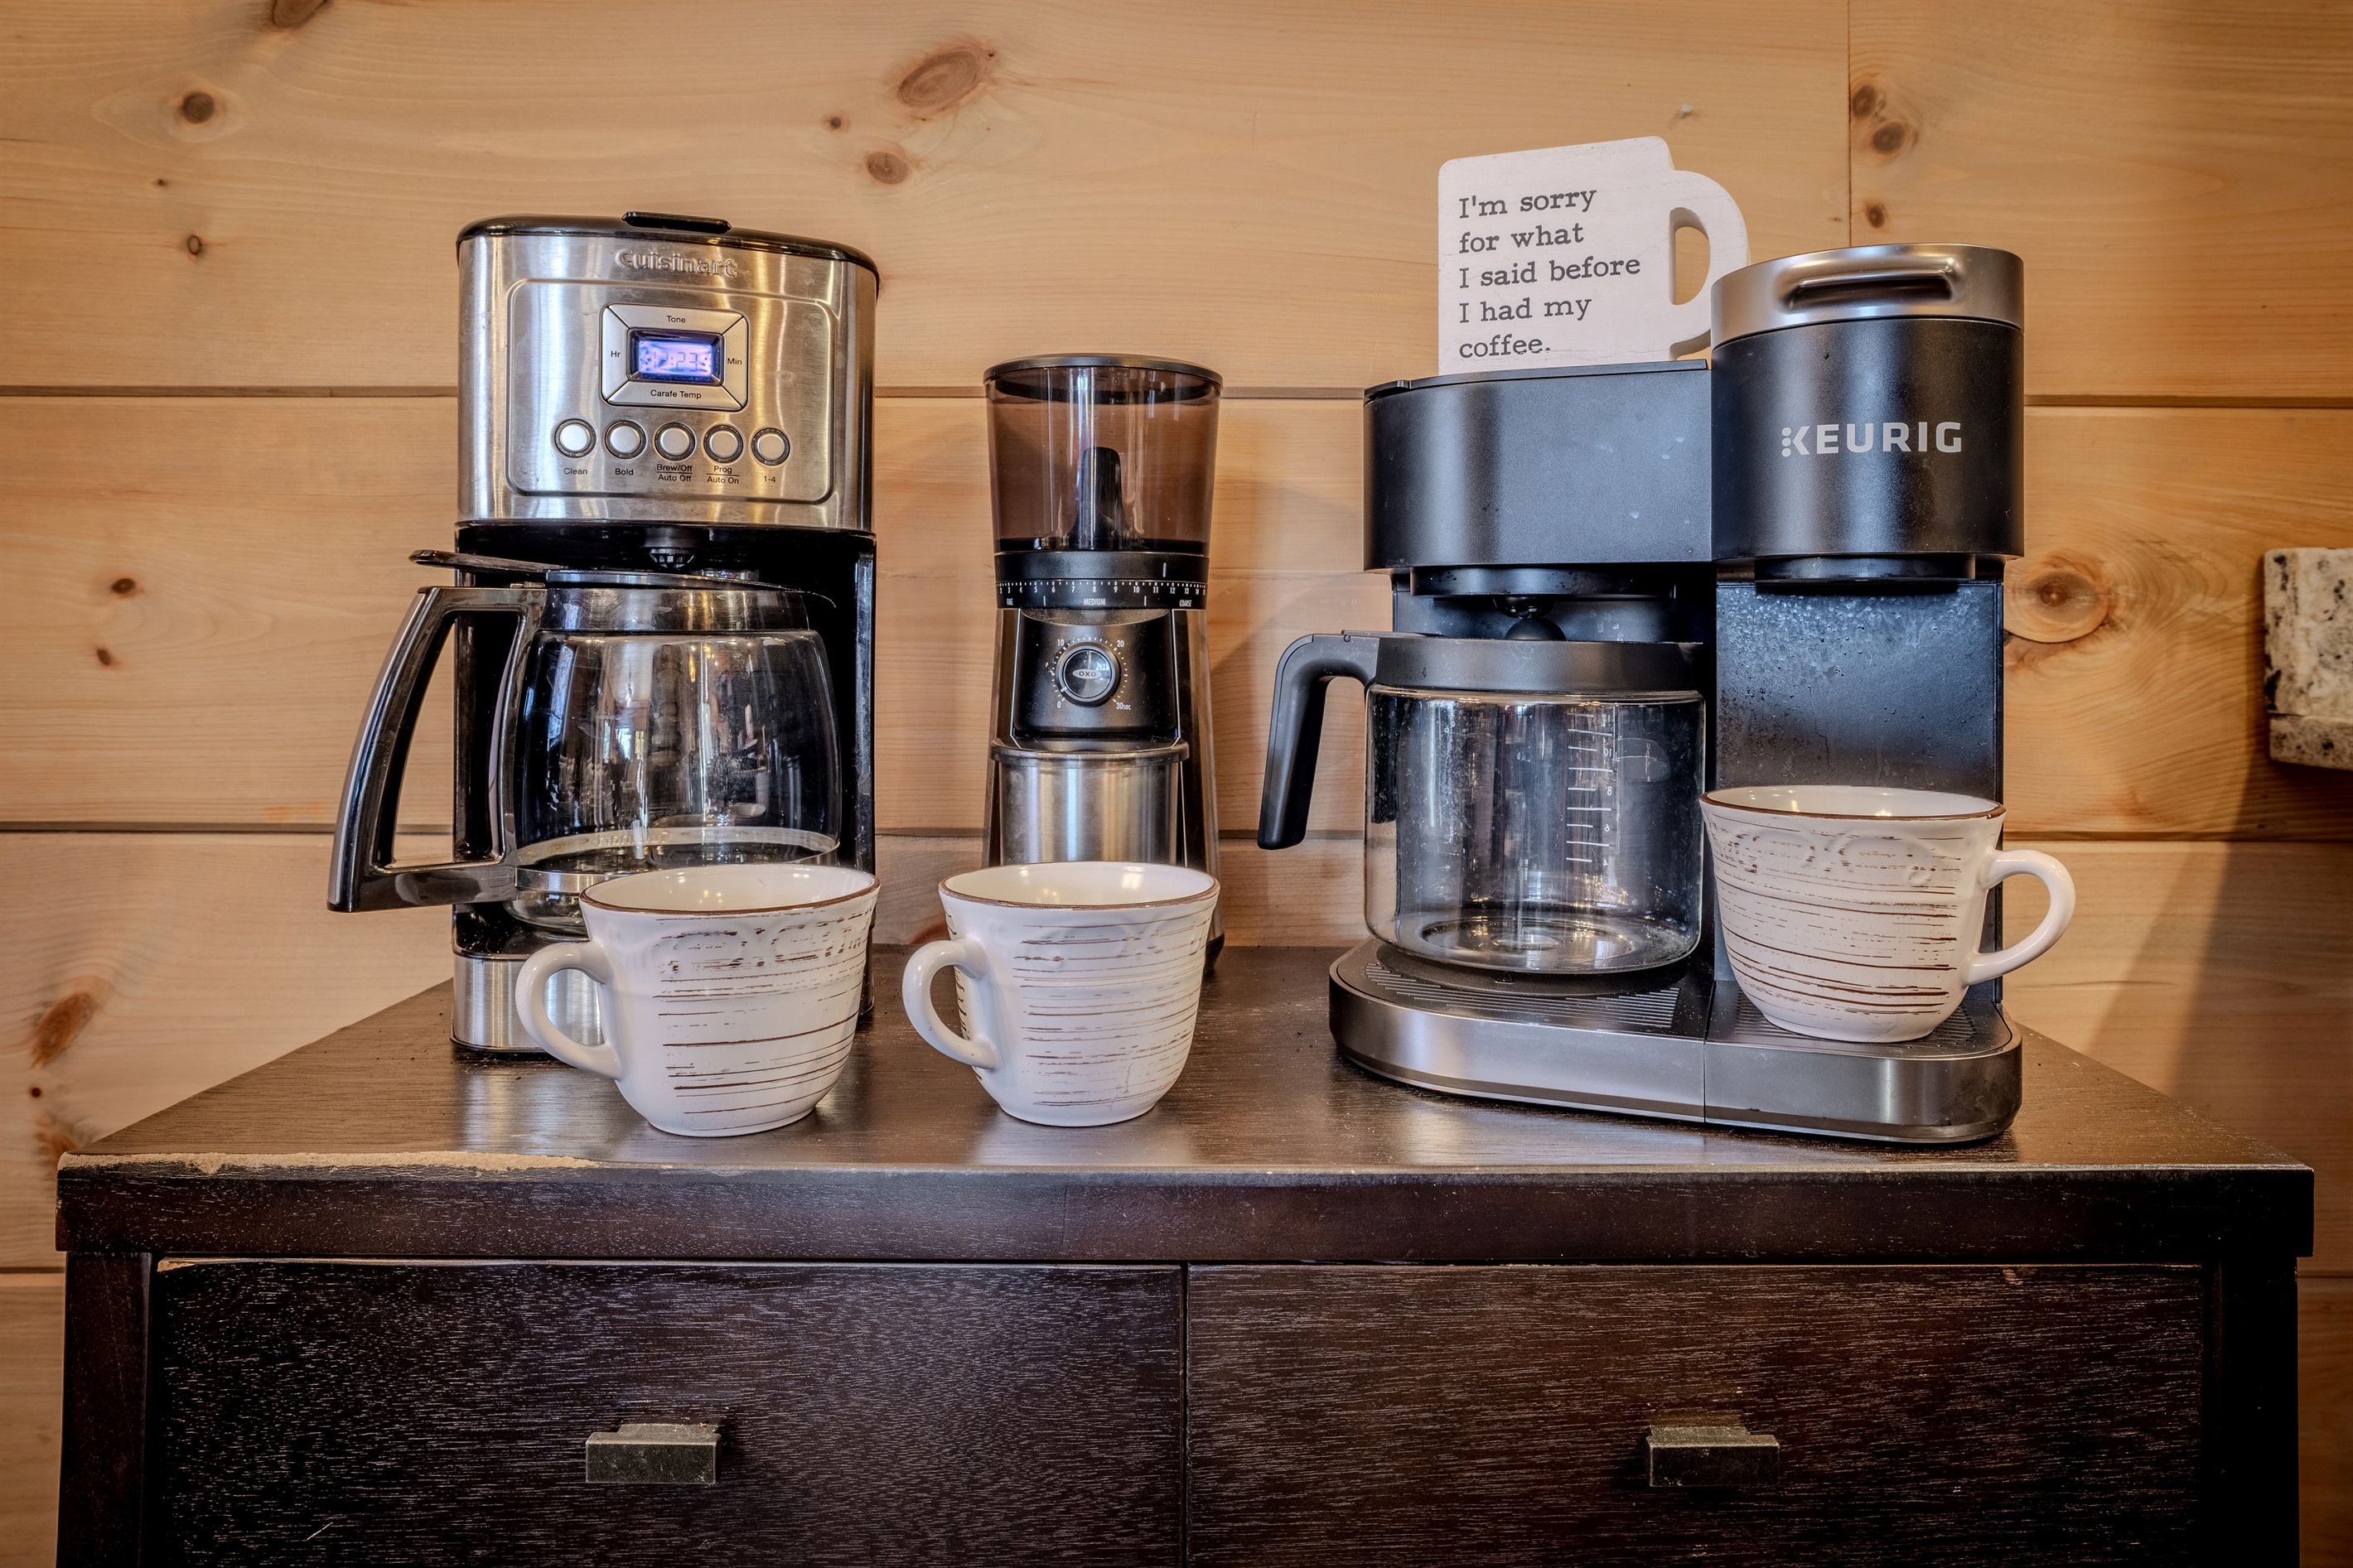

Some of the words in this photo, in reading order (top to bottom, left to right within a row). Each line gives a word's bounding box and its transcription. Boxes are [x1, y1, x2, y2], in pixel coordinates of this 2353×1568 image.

[1459, 195, 1508, 219] I'm
[1520, 189, 1597, 212] sorry
[1459, 232, 1500, 254] for
[1510, 222, 1584, 248] what
[615, 248, 737, 277] Cuisinart
[1459, 268, 1470, 288] I
[1480, 262, 1537, 287] said
[1549, 256, 1641, 282] before
[1459, 302, 1470, 324] I
[1480, 297, 1532, 322] had
[1544, 298, 1592, 321] my
[666, 315, 686, 324] Tone
[1459, 333, 1551, 359] coffee.
[727, 357, 742, 365] Min
[650, 389, 678, 398] Carafe
[679, 391, 702, 399] Temp
[1781, 421, 1962, 457] KEURIG
[563, 467, 588, 475] Clean
[615, 467, 634, 475] Bold
[656, 464, 693, 472] Brew/Off
[713, 466, 732, 475] Prog
[679, 473, 692, 482] Off
[707, 475, 726, 484] Auto
[727, 476, 739, 485] On
[1152, 586, 1159, 594] 11
[1083, 597, 1106, 606] MEDIUM
[1116, 639, 1125, 648] 20
[1056, 701, 1061, 709] 0
